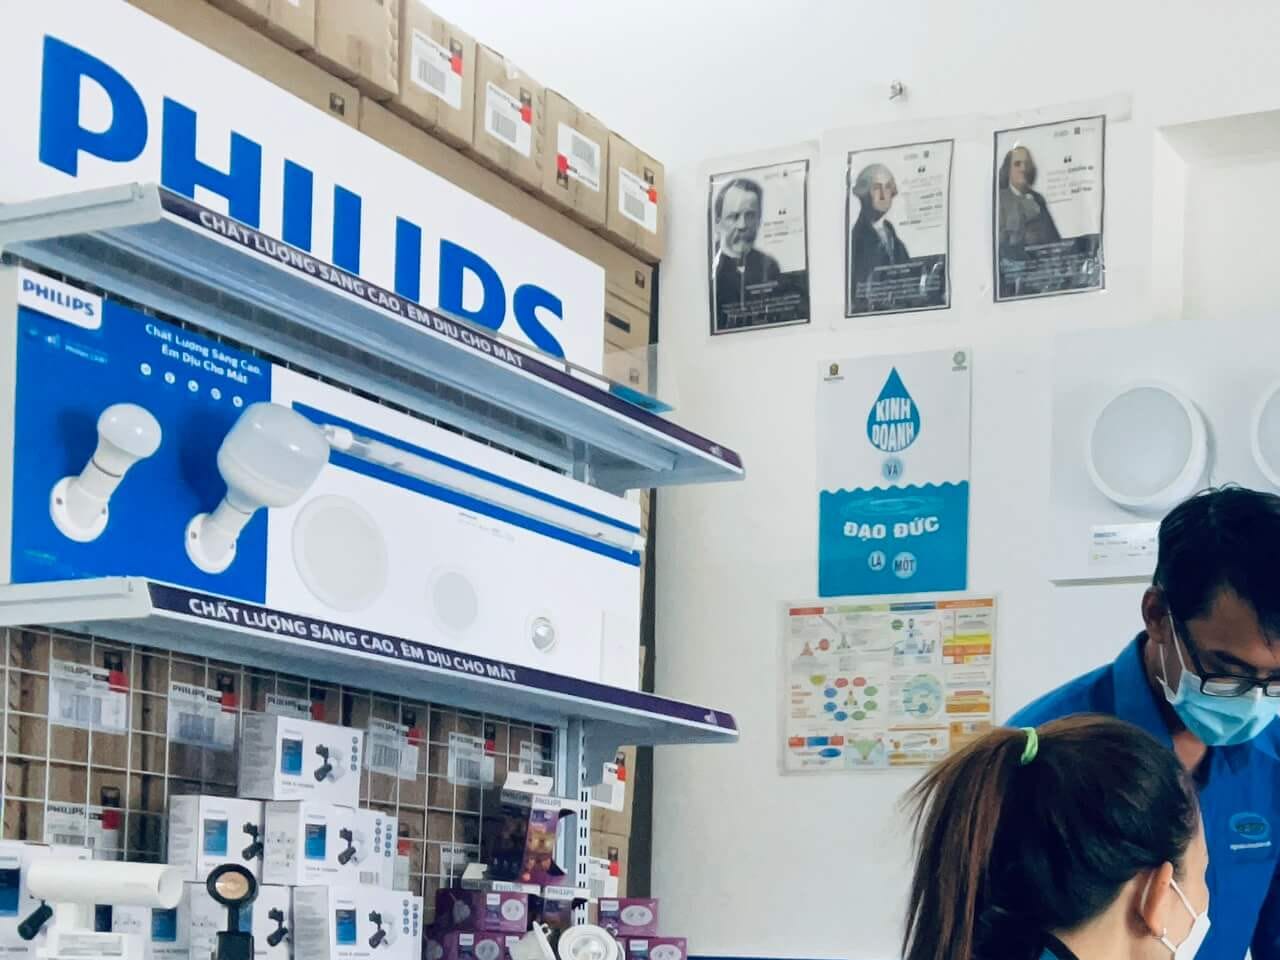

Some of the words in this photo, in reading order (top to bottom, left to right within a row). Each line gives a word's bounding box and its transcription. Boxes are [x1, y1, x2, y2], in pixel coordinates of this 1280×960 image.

[22, 278, 95, 317] PHILIPS
[461, 330, 491, 354] CHO
[875, 397, 911, 423] KINH
[871, 422, 915, 452] DOANH
[843, 520, 887, 542] ĐẠO
[893, 515, 940, 539] ĐỨC
[188, 598, 239, 624] CHẤT
[243, 609, 307, 636] LƯỢNG
[310, 622, 357, 647] SÁNG
[360, 634, 399, 657] CAO,
[400, 641, 424, 660] ÊM
[427, 651, 451, 669] DỊU
[454, 657, 485, 674] CHO
[47, 805, 84, 818] PHILIPS
